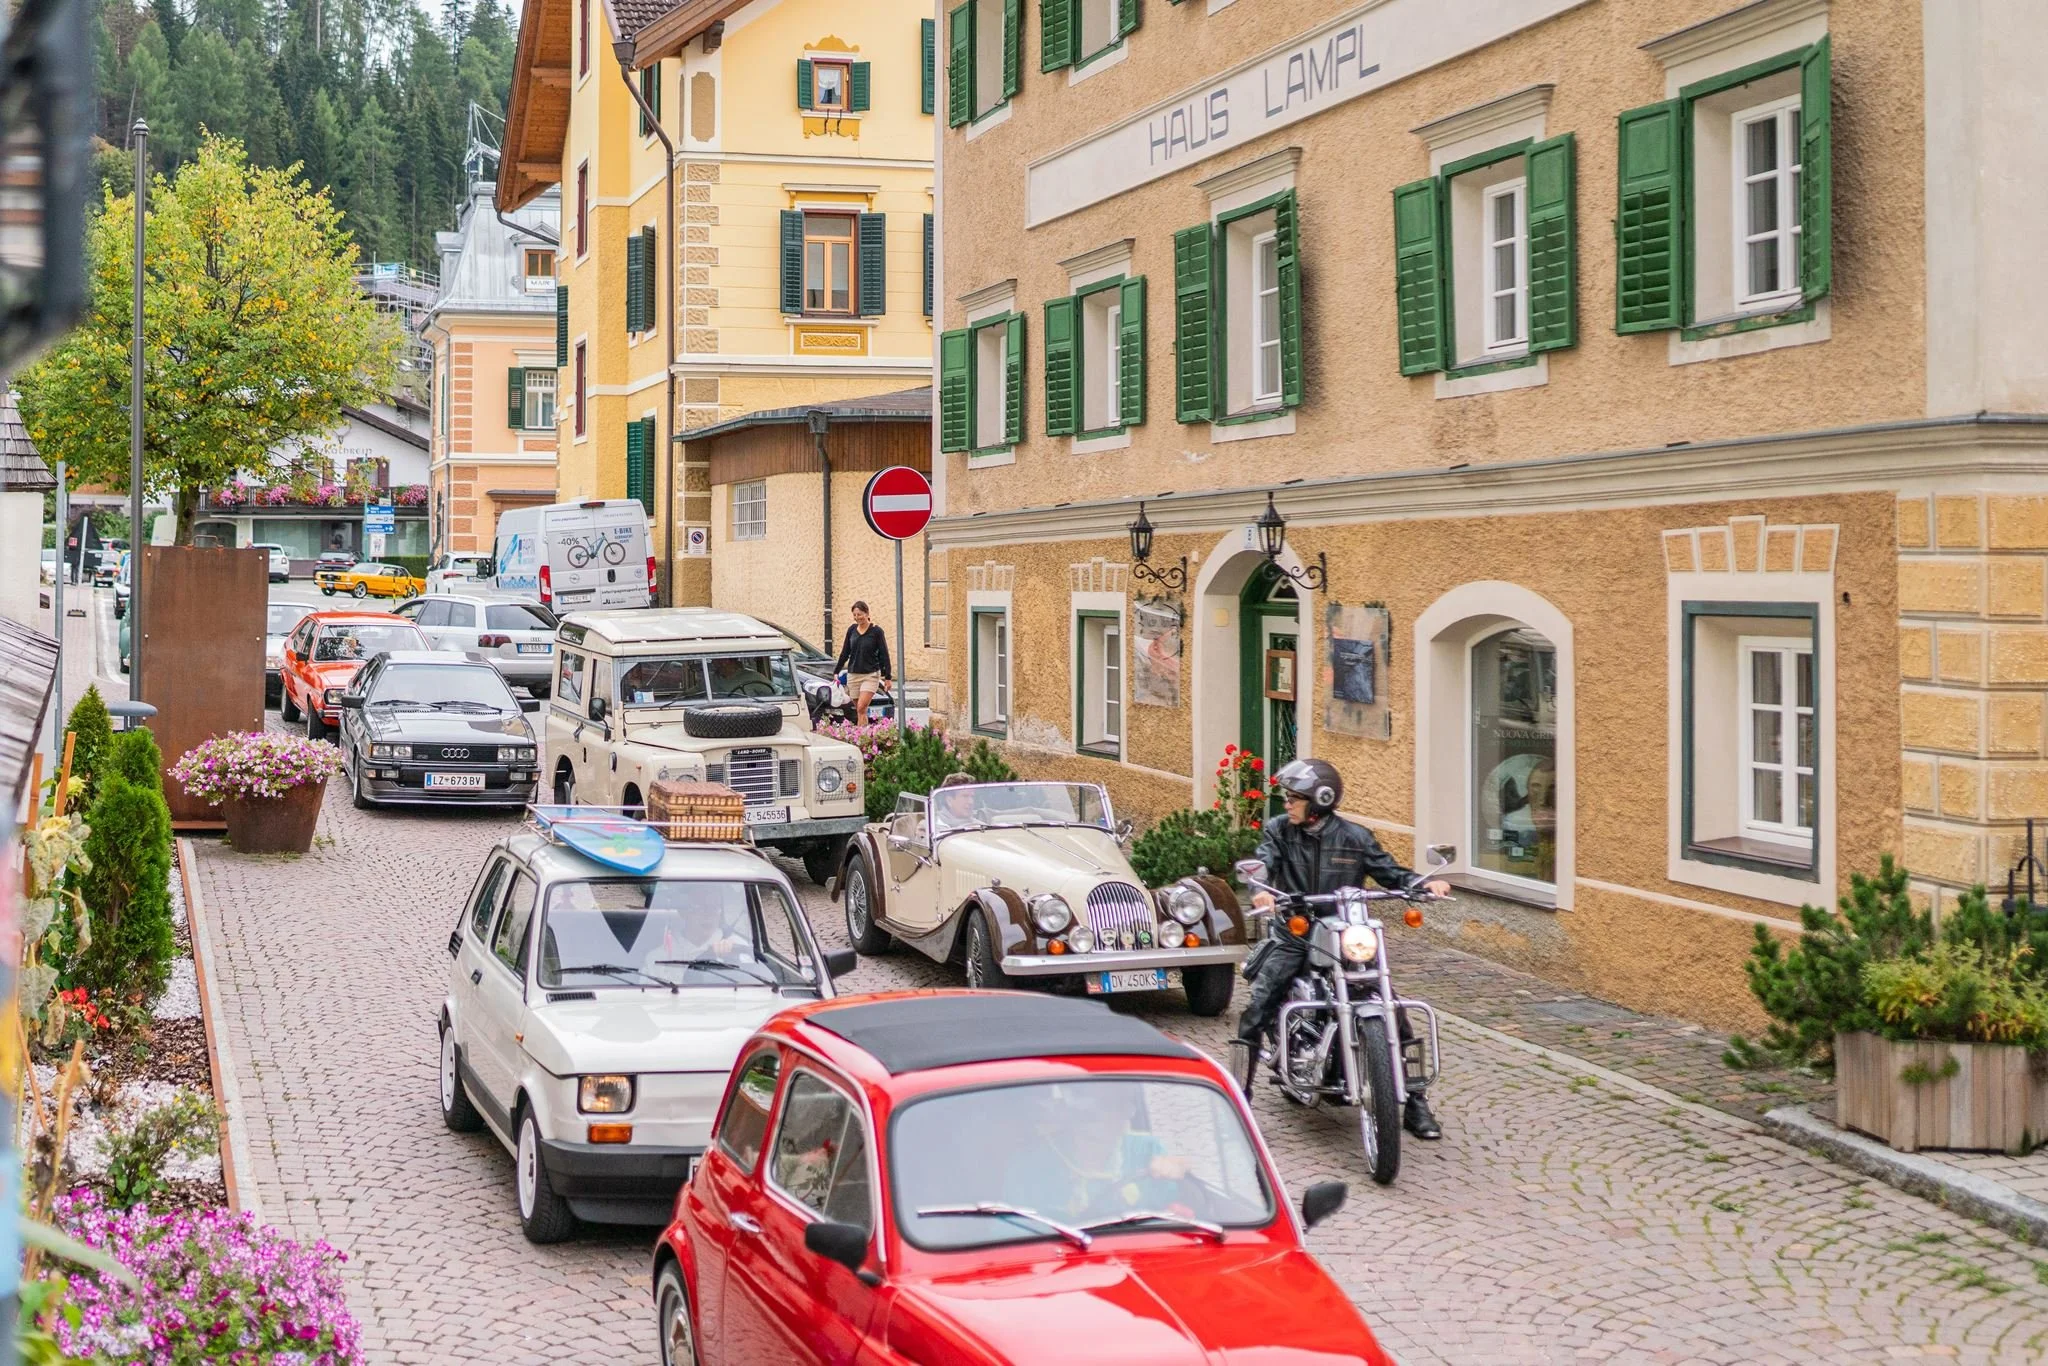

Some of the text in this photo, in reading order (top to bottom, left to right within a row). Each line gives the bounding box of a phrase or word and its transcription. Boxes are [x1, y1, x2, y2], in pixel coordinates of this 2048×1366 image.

[1149, 23, 1381, 167] HAUS LAMPL
[756, 809, 786, 821] 545536
[1111, 973, 1158, 988] DV 450KS
